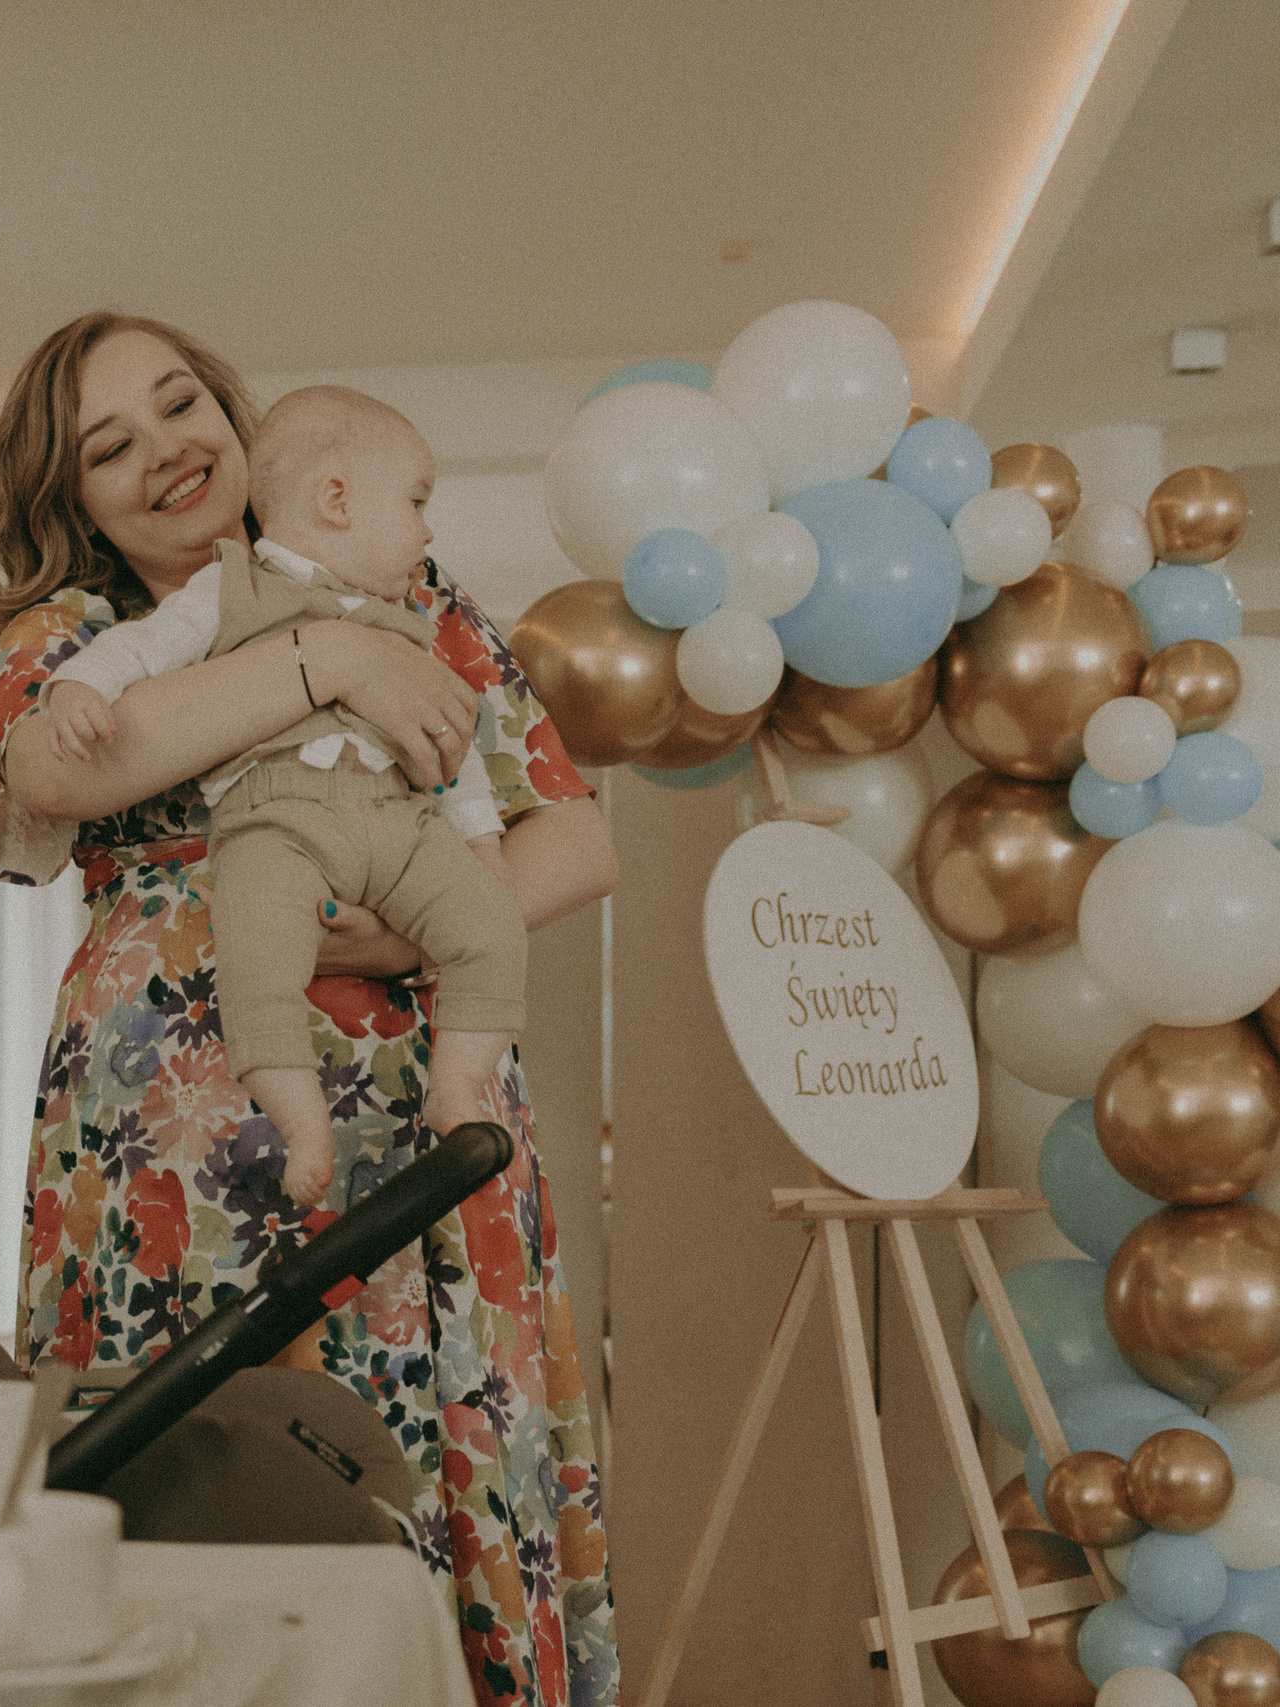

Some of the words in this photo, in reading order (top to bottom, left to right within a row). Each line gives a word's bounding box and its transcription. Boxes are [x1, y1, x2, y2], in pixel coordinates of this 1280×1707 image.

[750, 891, 881, 949] Chrzest
[786, 960, 899, 1035] Święty
[794, 1036, 949, 1097] Leonarda
